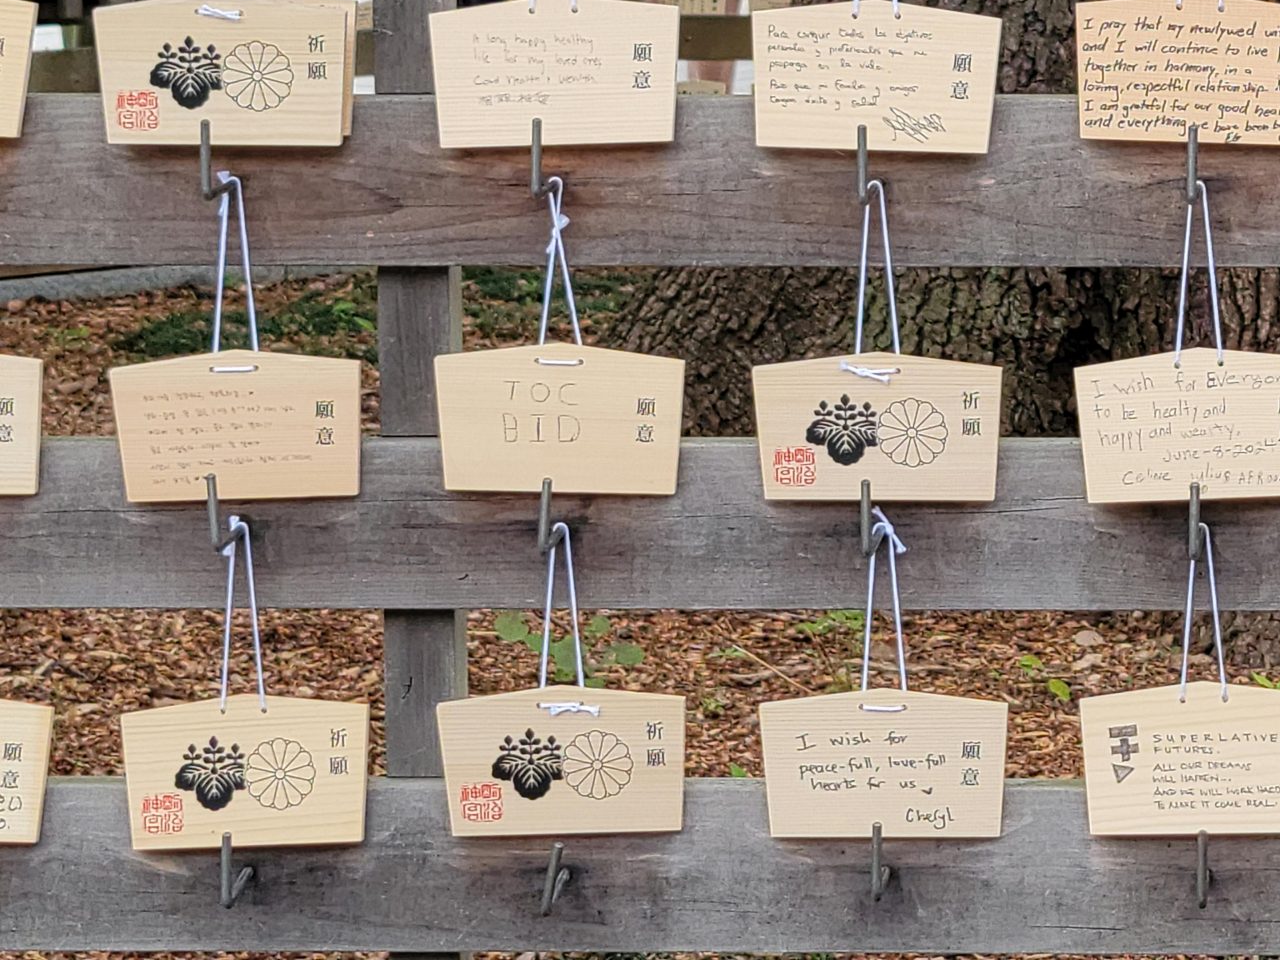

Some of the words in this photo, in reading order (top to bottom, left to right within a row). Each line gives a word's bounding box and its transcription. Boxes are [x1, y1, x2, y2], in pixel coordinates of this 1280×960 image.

[768, 24, 789, 38] Para
[1083, 18, 1094, 30] I
[1098, 22, 1126, 37] pray
[1135, 16, 1162, 31] that
[1166, 23, 1183, 38] my
[1190, 22, 1257, 41] newlywed
[514, 34, 546, 52] happy
[554, 34, 593, 53] healthy
[1083, 37, 1109, 52] and
[1114, 41, 1125, 53] I
[1135, 40, 1157, 52] will
[1161, 45, 1218, 55] continue
[1225, 45, 1239, 55] to
[1246, 44, 1268, 57] live
[307, 34, 327, 80] 祈願
[528, 57, 544, 74] my
[631, 42, 653, 89] 願意
[949, 53, 972, 100] 願意
[1085, 59, 1137, 83] together
[1145, 61, 1157, 71] in
[1165, 60, 1219, 77] harmony,
[1224, 65, 1238, 75] in
[1084, 80, 1124, 102] loving,
[1126, 81, 1189, 92] respectful
[1085, 100, 1094, 110] I
[1123, 101, 1165, 117] grateful
[1170, 101, 1188, 110] for
[1195, 104, 1211, 112] our
[1218, 100, 1250, 119] good
[1085, 117, 1112, 128] and
[1118, 116, 1186, 136] everything
[1214, 122, 1239, 133] have
[504, 380, 578, 406] TOC
[1091, 380, 1104, 398] I
[1114, 372, 1154, 395] wish
[1175, 371, 1196, 392] for
[635, 398, 656, 443] 願意
[962, 391, 981, 436] 祈願
[1094, 405, 1110, 417] to
[1122, 403, 1138, 419] be
[1203, 398, 1226, 419] and
[315, 400, 335, 446] 願意
[503, 413, 581, 443] BID
[1098, 430, 1143, 451] happy
[1149, 423, 1172, 439] and
[646, 721, 666, 767] 祈願
[796, 733, 816, 751] I
[830, 732, 871, 746] wish
[884, 731, 907, 745] for
[1152, 733, 1278, 743] SUPERLATIVE
[329, 728, 349, 775] 祈願
[960, 741, 981, 786] 願意
[0, 743, 22, 789] 願意
[799, 758, 880, 779] peace-full,
[888, 754, 946, 769] love-full
[1153, 763, 1176, 772] ALL
[1180, 762, 1202, 770] OUR
[1208, 762, 1252, 771] DREAMS
[811, 777, 856, 791] hearts
[867, 777, 885, 790] for
[900, 781, 916, 789] us
[1154, 787, 1176, 796] AND
[1257, 786, 1280, 794] HARD
[1154, 800, 1165, 809] TO
[1169, 800, 1196, 809] MAKE
[1215, 800, 1241, 808] COME
[906, 807, 955, 830] Cheryl
